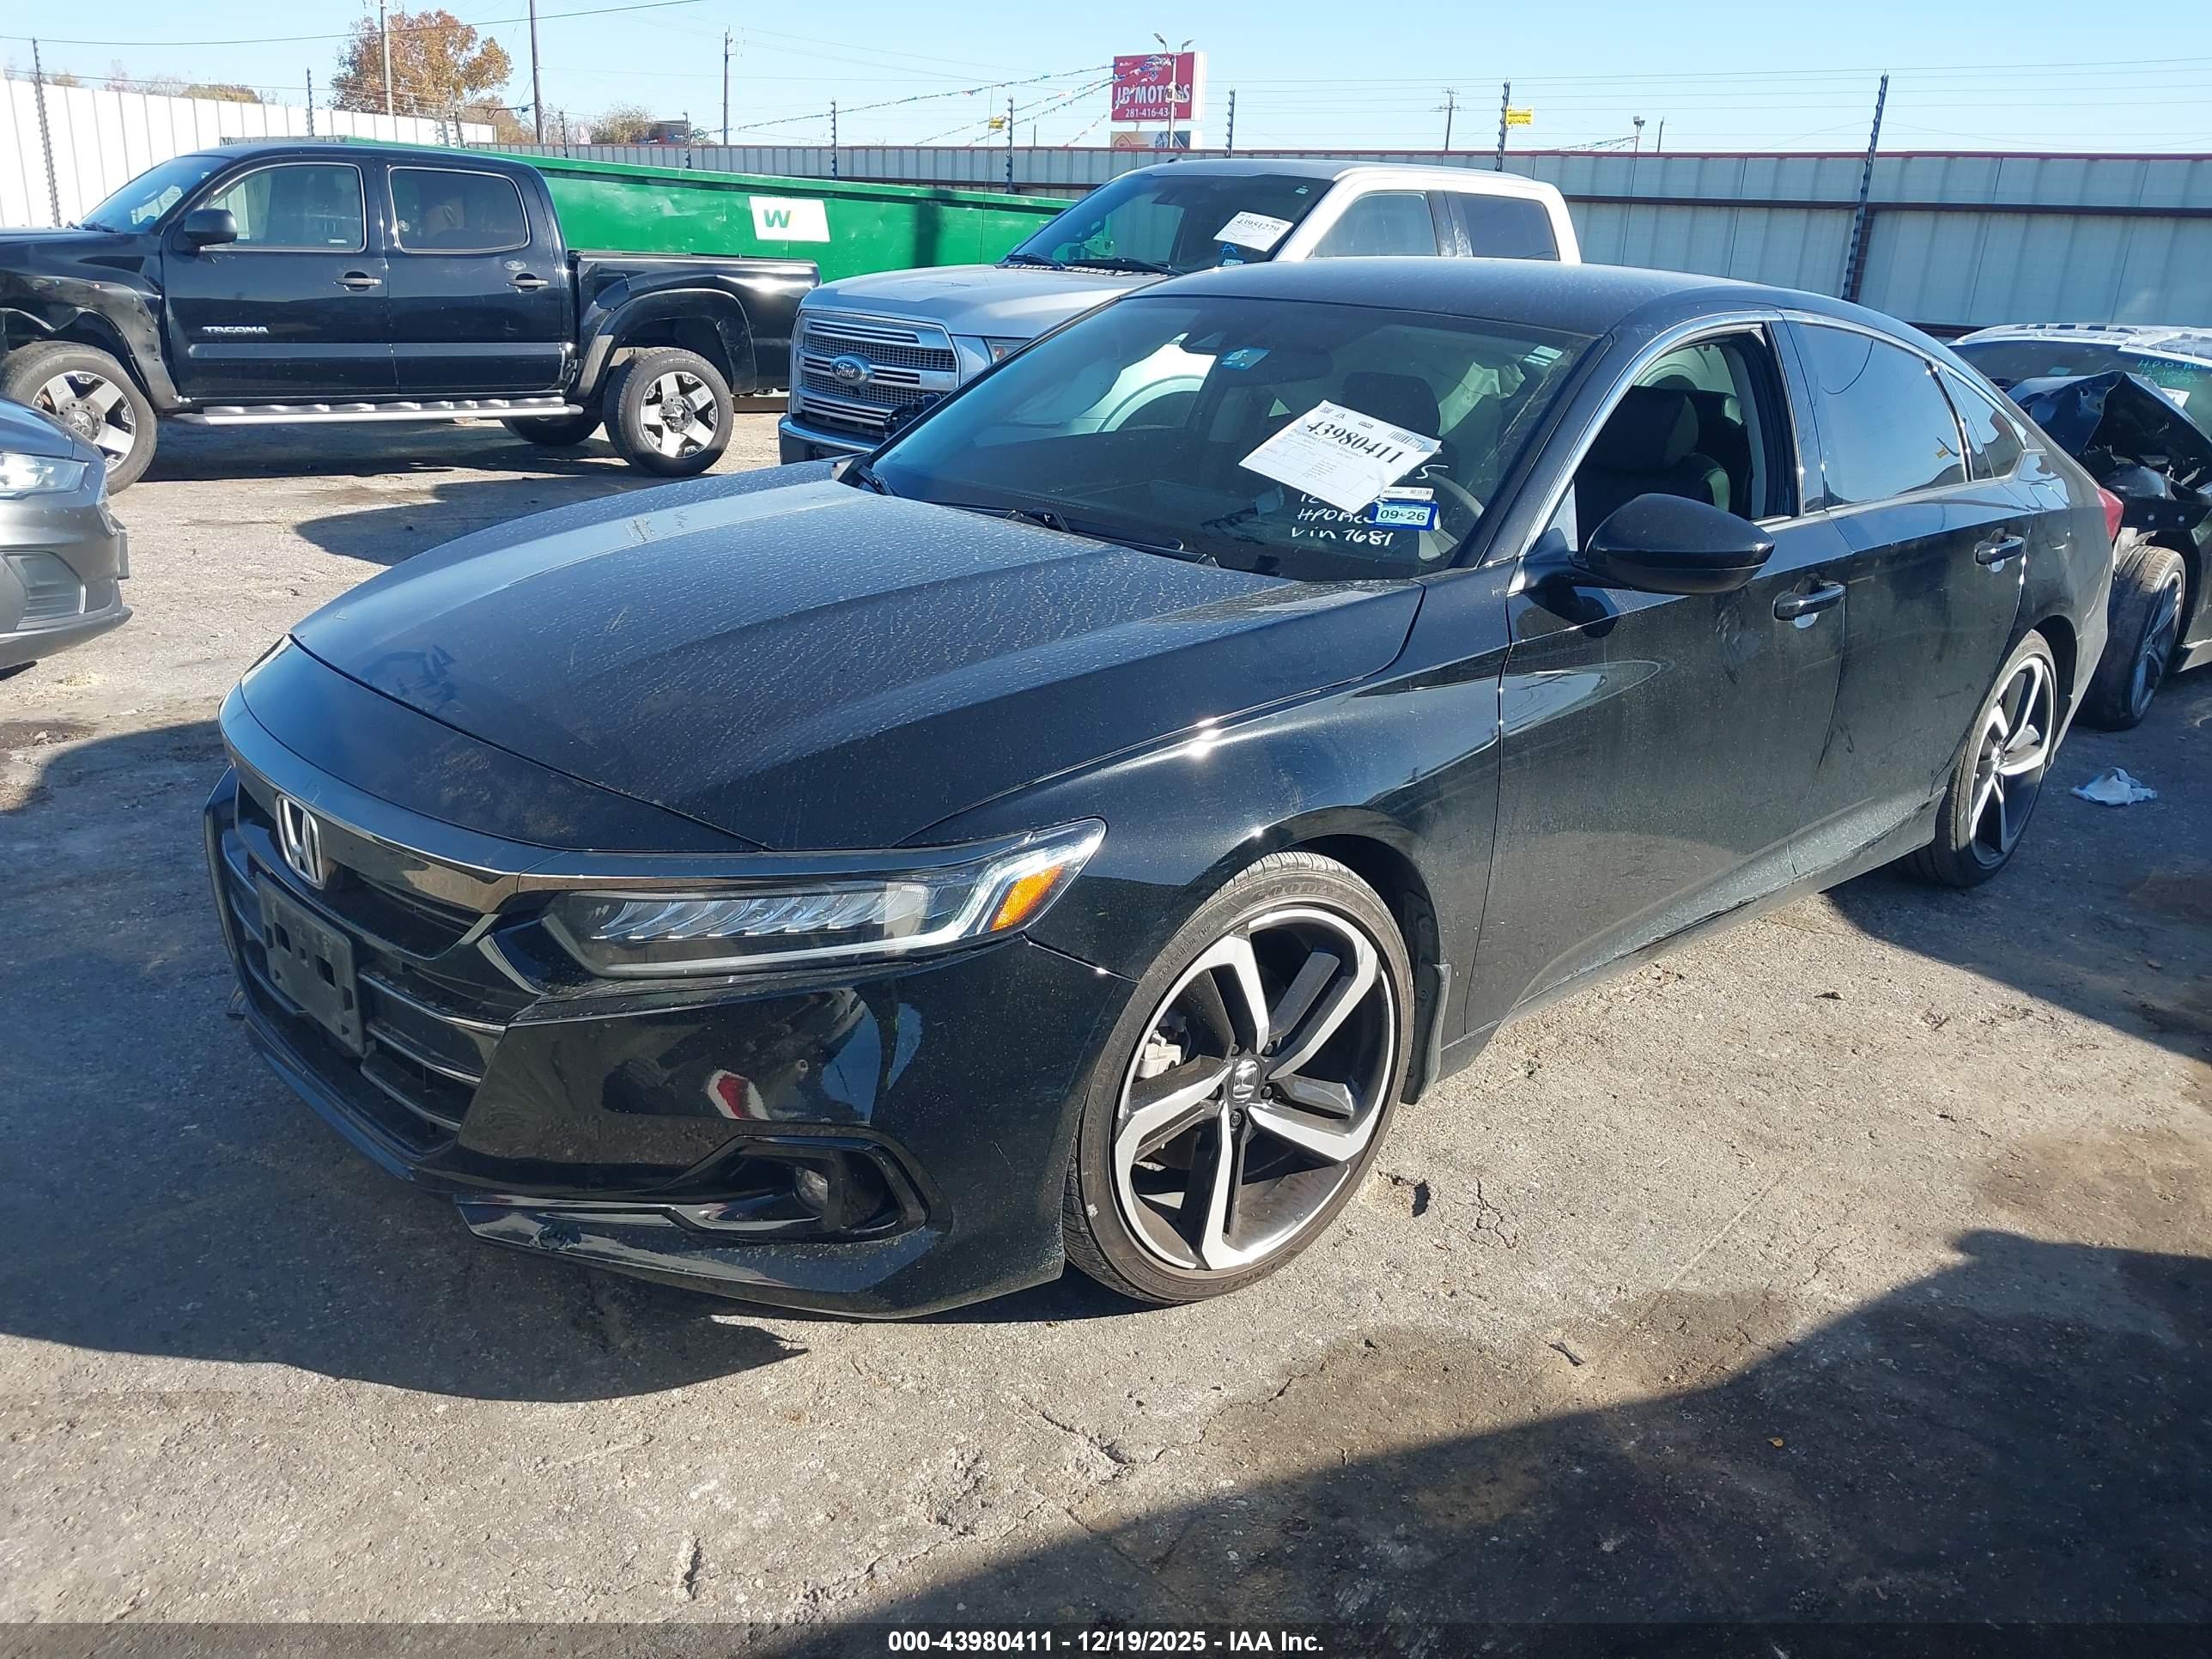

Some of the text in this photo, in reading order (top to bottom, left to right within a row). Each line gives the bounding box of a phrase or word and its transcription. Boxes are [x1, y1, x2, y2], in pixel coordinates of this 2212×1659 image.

[1126, 107, 1177, 118] 281-416-431
[836, 362, 856, 378] Ford
[1307, 421, 1404, 463] 43980411
